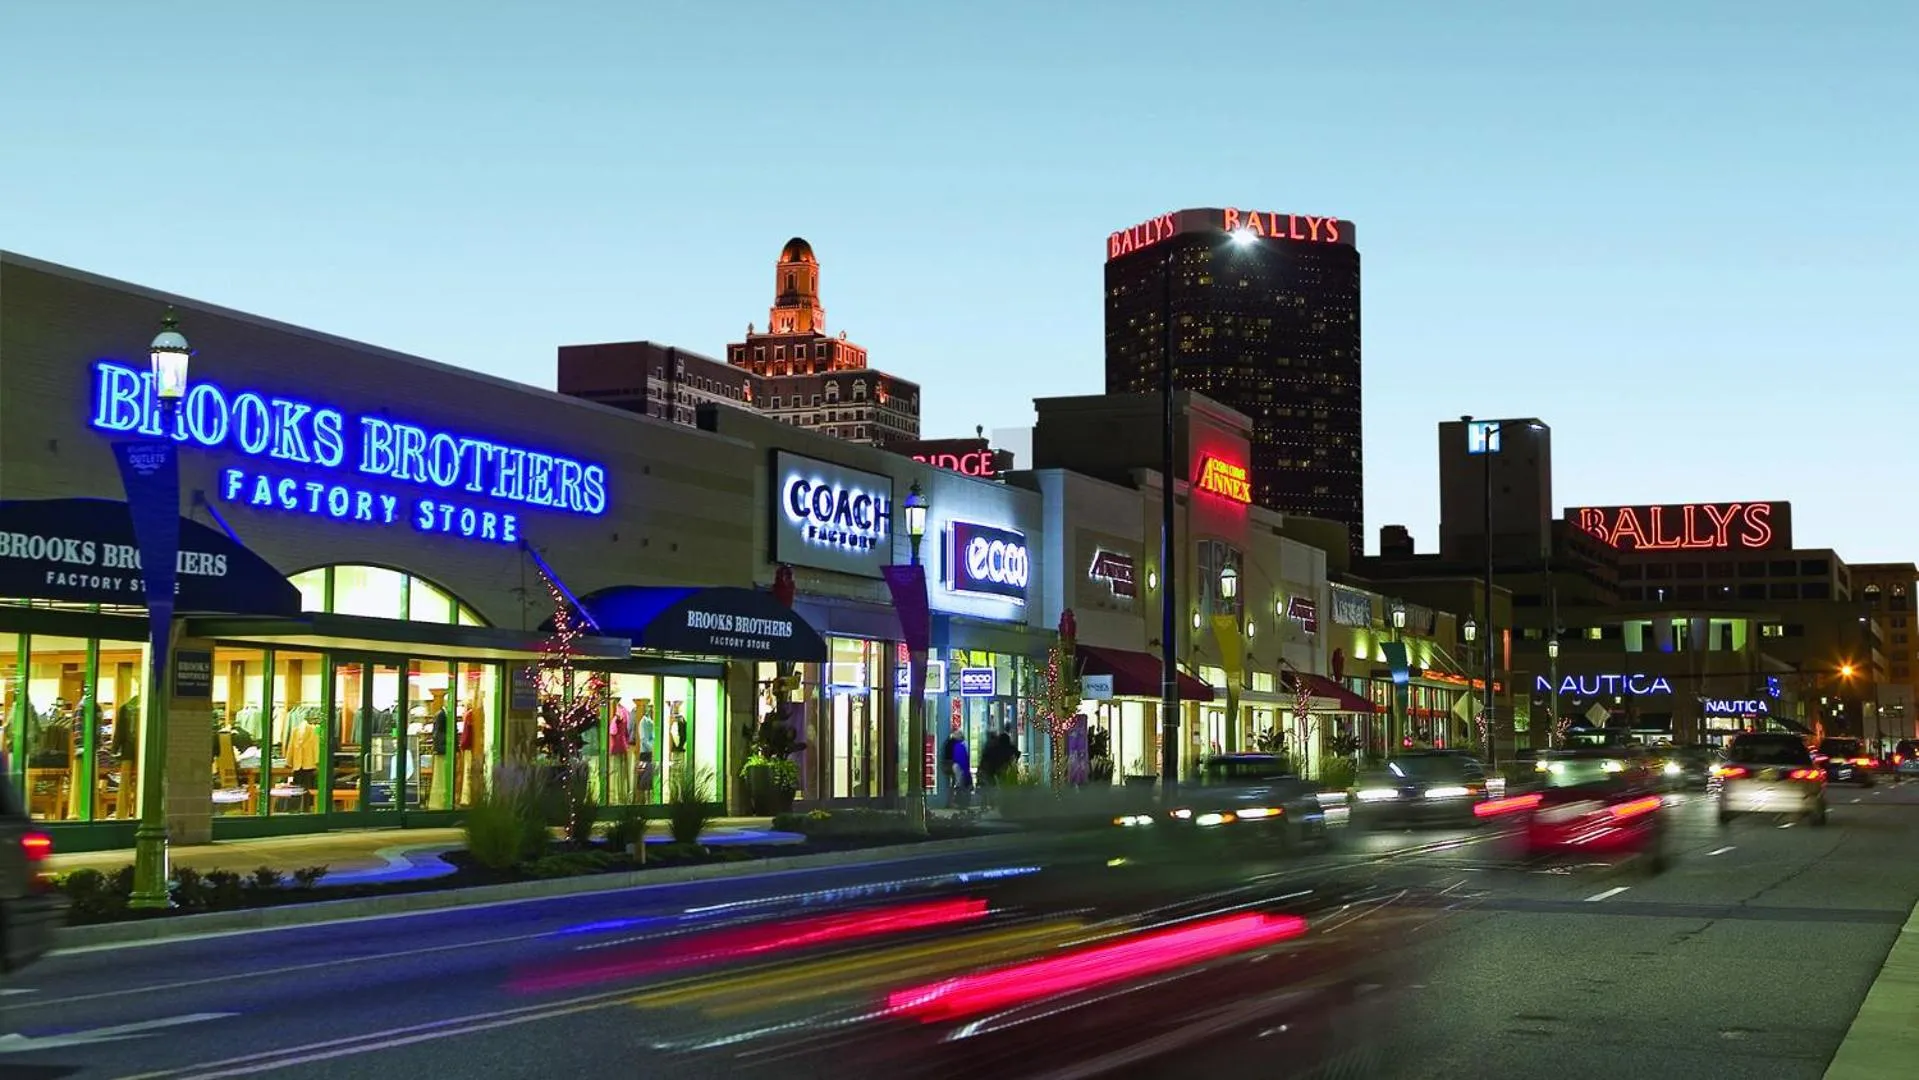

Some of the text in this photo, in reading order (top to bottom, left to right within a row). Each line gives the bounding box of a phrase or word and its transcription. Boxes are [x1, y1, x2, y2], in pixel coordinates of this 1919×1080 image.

[1111, 213, 1174, 258] BALLYS
[1223, 207, 1340, 243] BALLYS
[359, 416, 605, 514] BROTHERS
[226, 470, 517, 542] FACTORY STORE
[790, 480, 892, 534] COACH
[1580, 504, 1772, 549] BALLYS
[0, 531, 228, 577] BROOKS BRERS
[46, 571, 122, 591] FACTORY
[687, 610, 793, 637] BROOKS BROTHERS
[709, 635, 771, 650] FACTORY STORE
[1536, 674, 1673, 695] NAUTICA
[1706, 700, 1768, 713] NAUTICA
